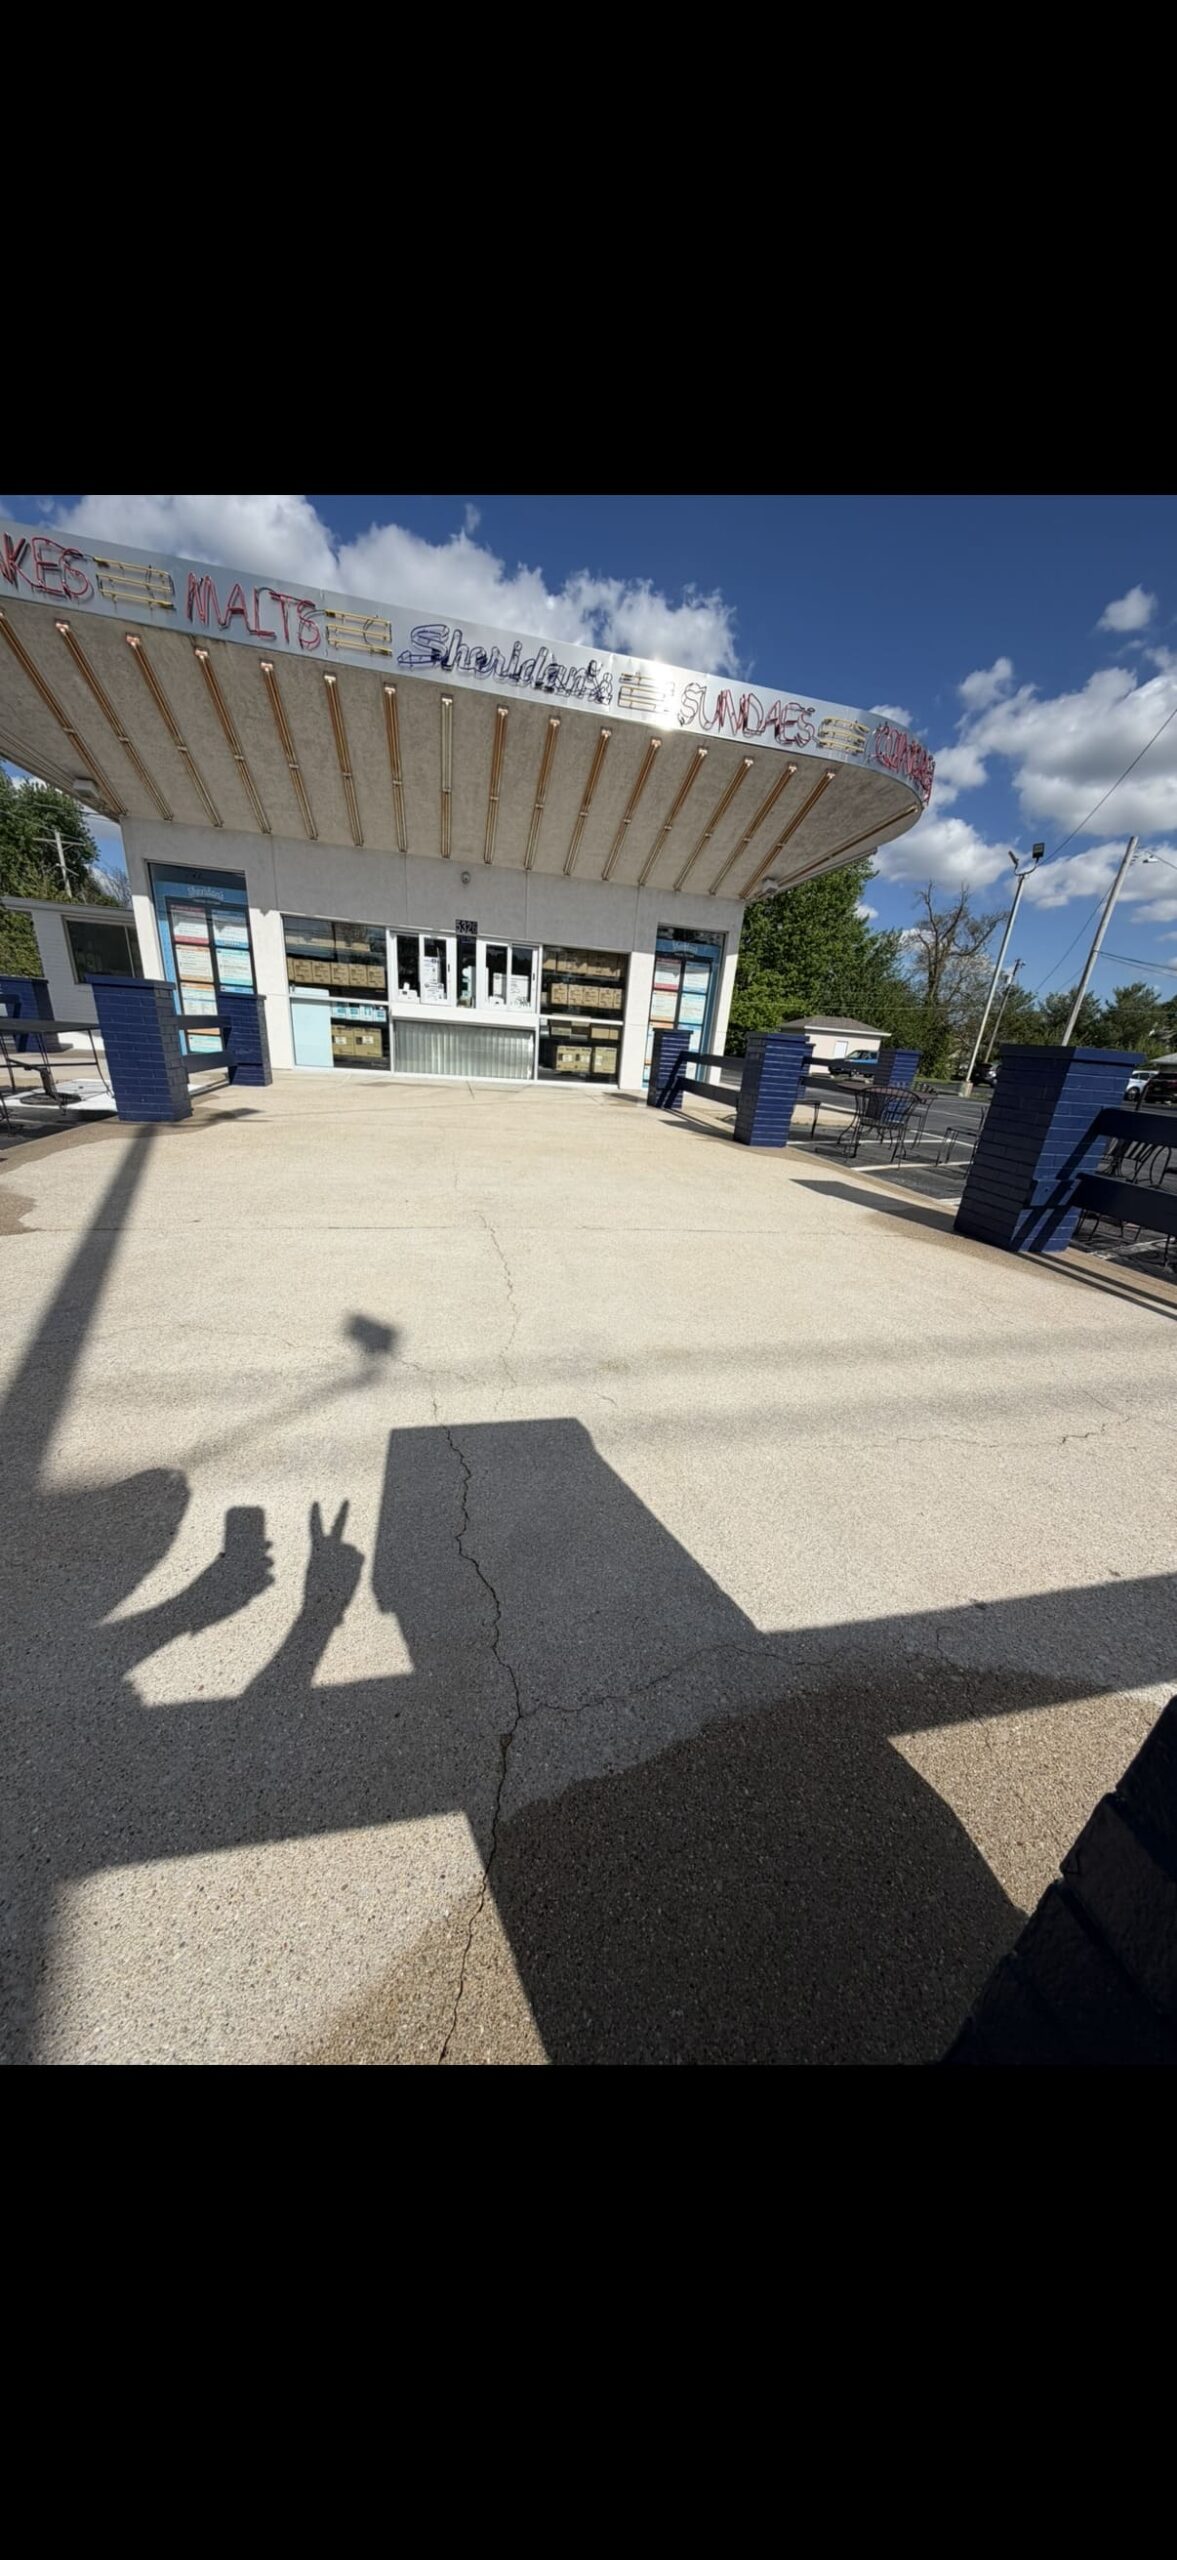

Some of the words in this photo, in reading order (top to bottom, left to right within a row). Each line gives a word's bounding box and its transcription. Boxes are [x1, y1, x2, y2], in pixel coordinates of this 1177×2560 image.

[0, 531, 92, 601] KES
[186, 571, 321, 650] MALTS
[397, 623, 613, 705] Sheridan's
[677, 681, 816, 748] SUNDAES
